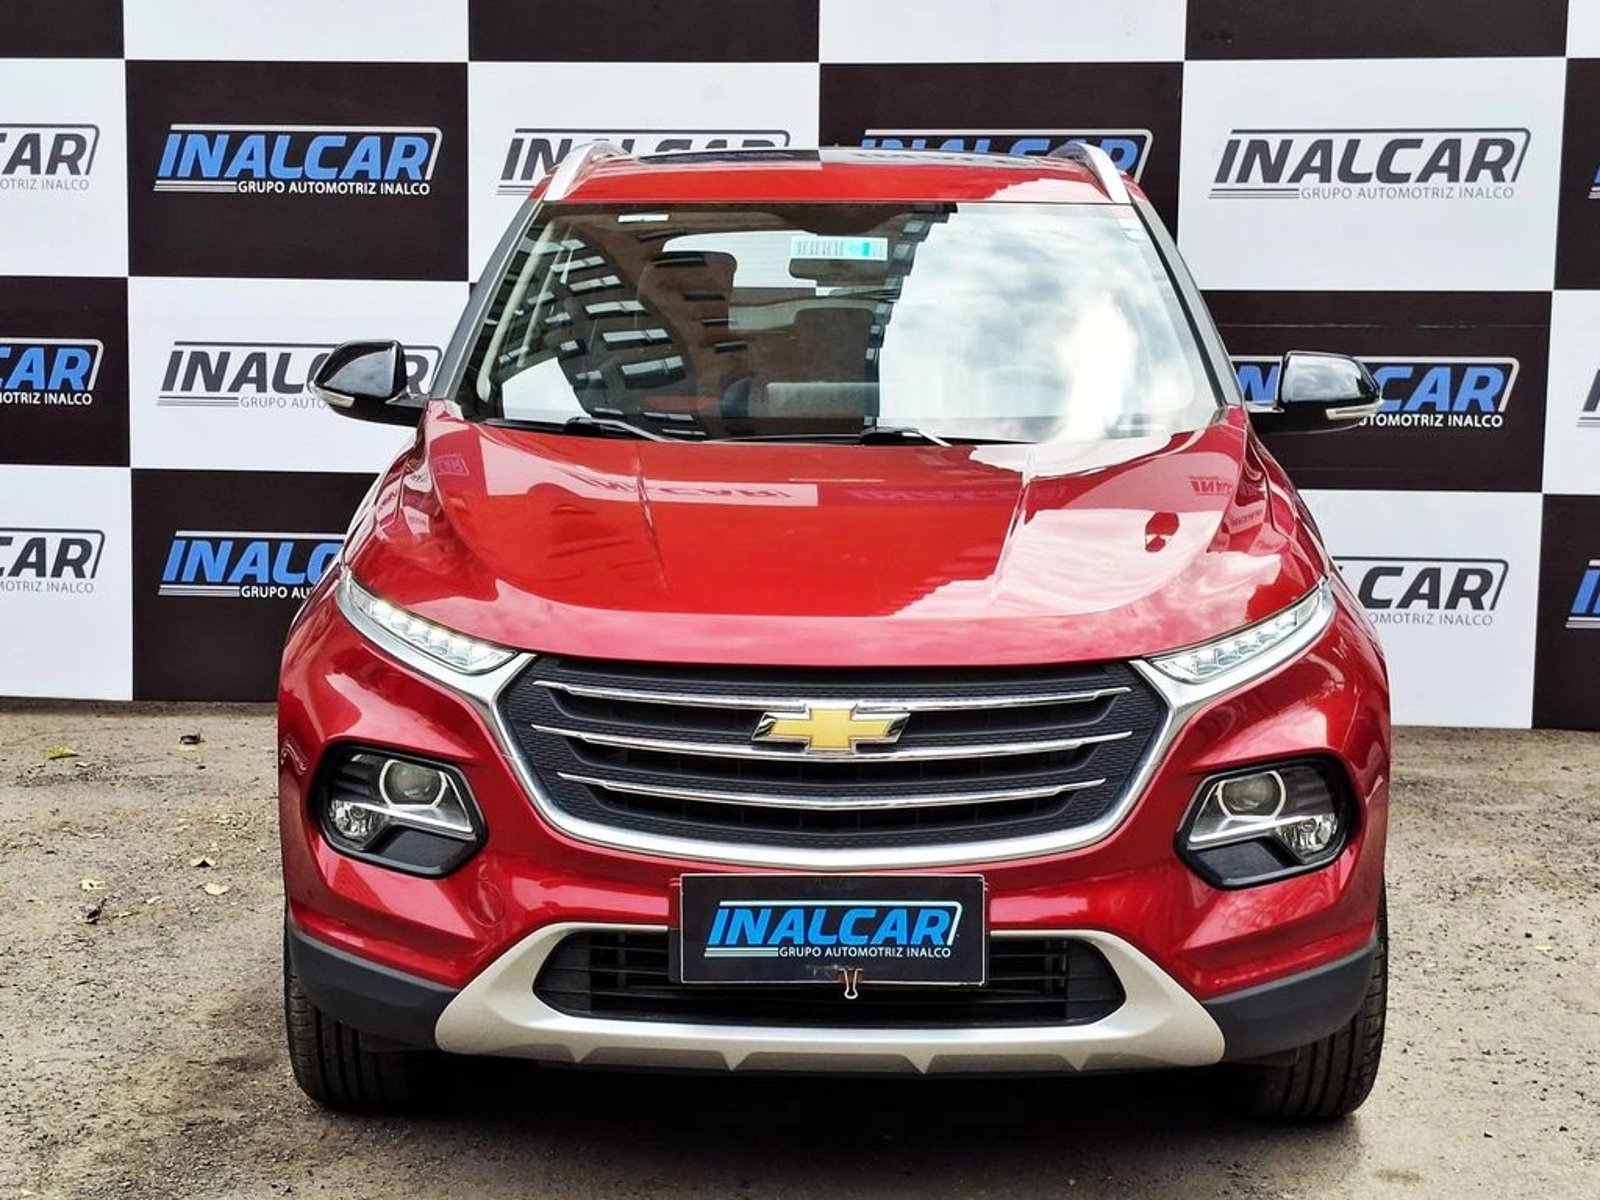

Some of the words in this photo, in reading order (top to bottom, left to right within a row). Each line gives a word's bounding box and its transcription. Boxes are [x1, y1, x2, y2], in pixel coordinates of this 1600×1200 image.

[157, 134, 429, 180] INALCAR
[1214, 138, 1516, 184] INALCAR
[41, 179, 90, 191] INALCO
[238, 180, 286, 194] GRUPO
[288, 181, 377, 195] AUTOMOTRIZ
[380, 182, 431, 196] INALCO
[1301, 187, 1352, 199] GRUPO
[1357, 187, 1454, 199] AUTOMOTRIZ
[1459, 187, 1515, 199] INALCO
[0, 391, 41, 404] OTRIZ
[44, 393, 93, 405] INALCO
[240, 396, 287, 409] GRUPO
[1447, 414, 1504, 428] INALCO
[46, 581, 94, 594] INALCO
[240, 586, 287, 599] GRUPO
[1339, 566, 1494, 611] CAR
[1439, 613, 1494, 626] INALCO
[708, 908, 951, 945] INALCAR
[779, 946, 821, 957] GRUPO
[824, 946, 903, 957] AUTOMOTRIZ
[906, 946, 951, 958] INALCO
